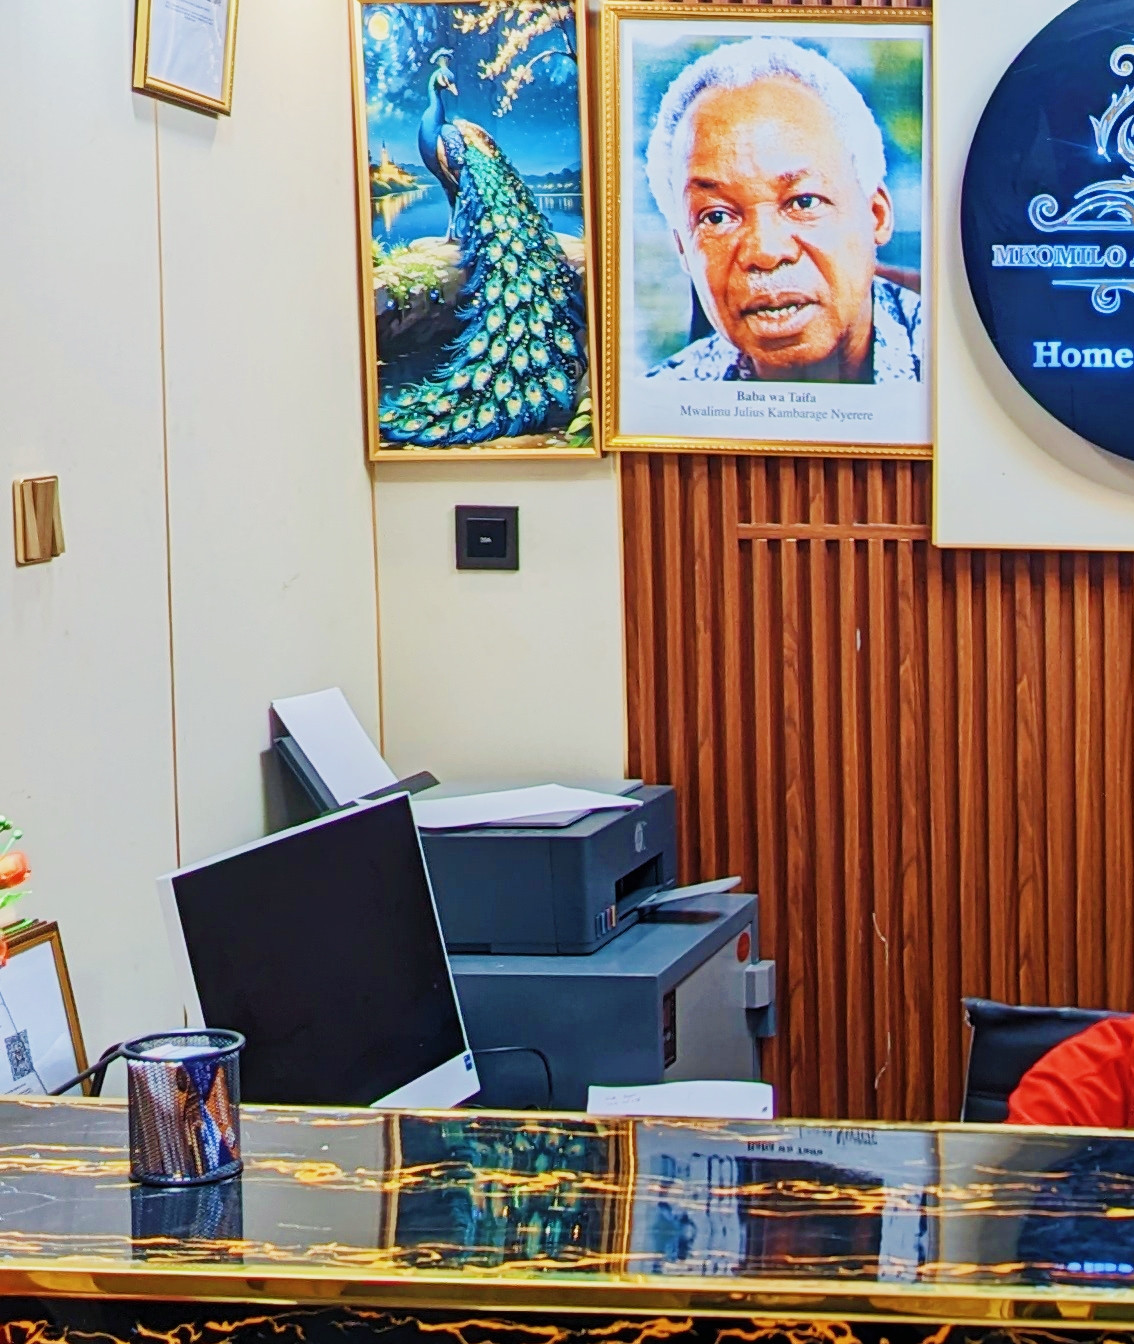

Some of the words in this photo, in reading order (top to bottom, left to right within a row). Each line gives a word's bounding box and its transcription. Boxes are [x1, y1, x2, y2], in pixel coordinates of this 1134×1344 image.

[991, 244, 1127, 268] MKOMILO
[1032, 341, 1134, 368] Home
[737, 390, 766, 402] Baba
[769, 394, 785, 403] wa
[788, 391, 817, 404] Taifa
[680, 404, 731, 417] Mwalimu
[733, 406, 765, 418] Julius
[768, 407, 828, 422] Kambarage
[831, 408, 874, 423] Nyerere
